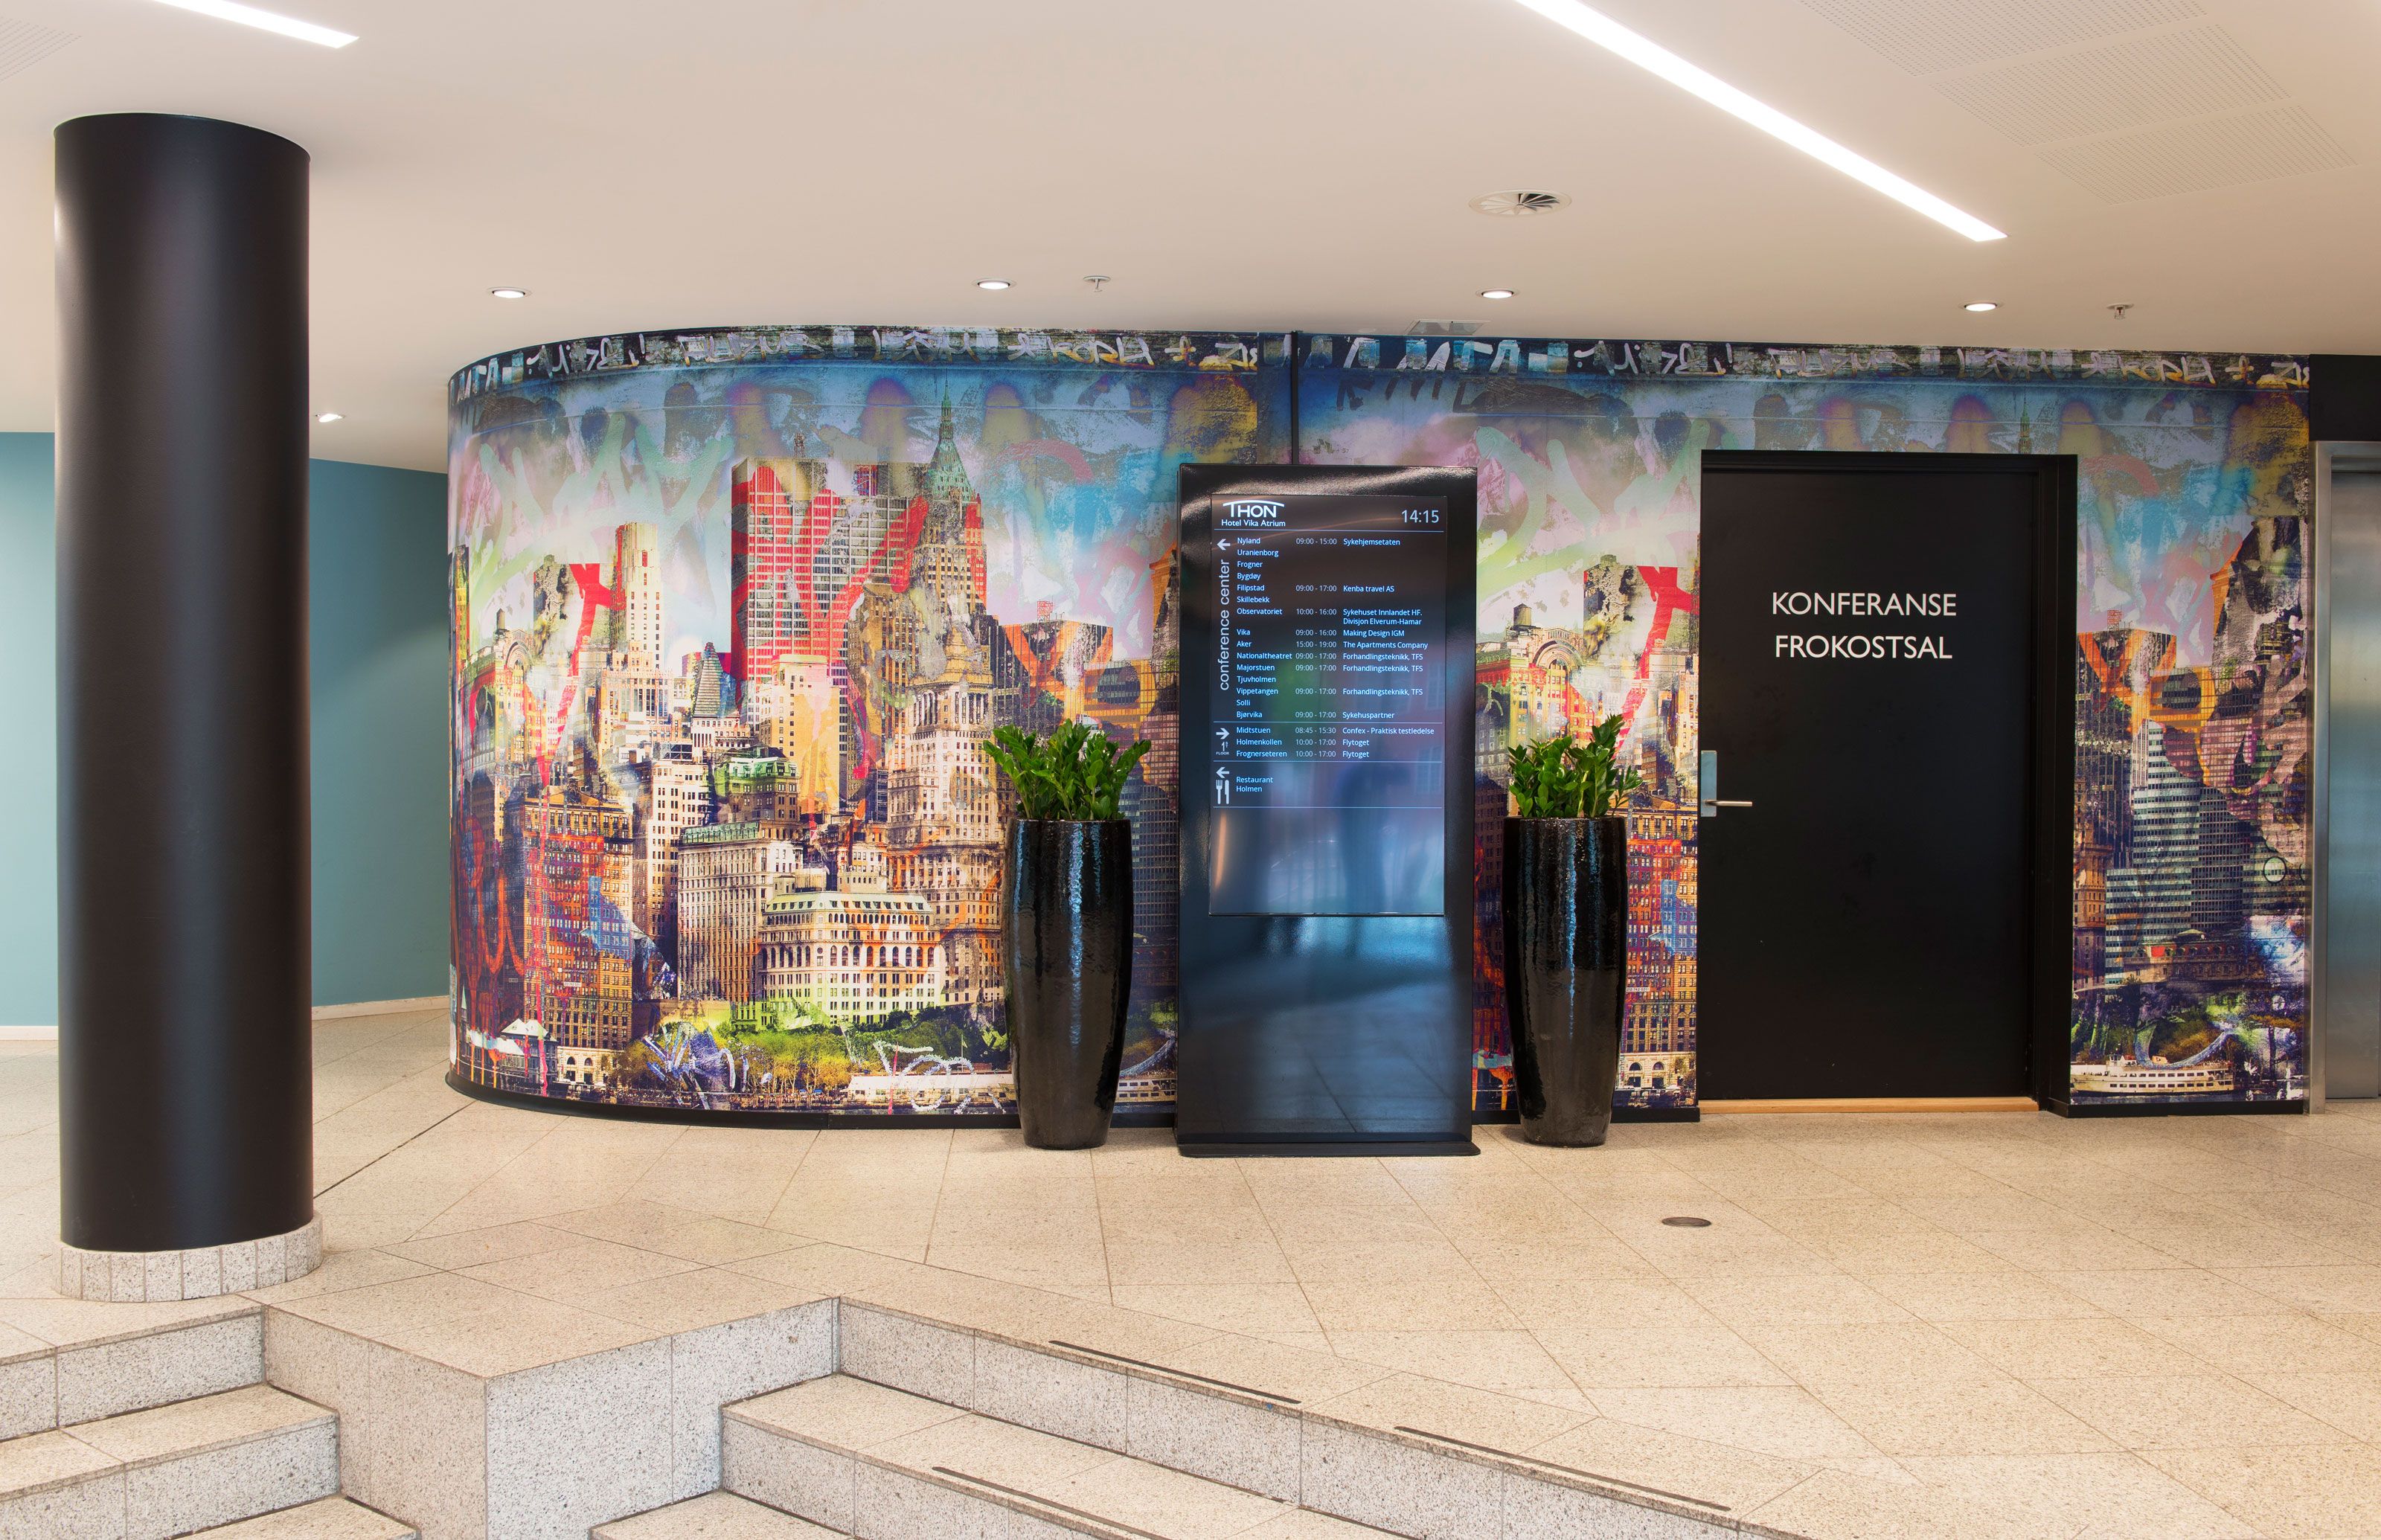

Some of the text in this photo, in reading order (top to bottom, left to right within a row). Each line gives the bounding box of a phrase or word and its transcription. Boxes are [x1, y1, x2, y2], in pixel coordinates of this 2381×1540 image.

[1222, 500, 1285, 518] THON
[1401, 510, 1439, 524] 14:15
[1221, 519, 1242, 527] Hotel
[1243, 519, 1259, 527] Vika
[1237, 537, 1261, 546] Nyland
[1343, 538, 1400, 547] Sykehjemsetaten
[1237, 549, 1279, 558] Uranienborg
[1237, 560, 1263, 569] Frogner
[1237, 572, 1261, 581] Bygdøy
[1237, 584, 1265, 593] Filipstad
[1772, 591, 1957, 616] KONFERANSE
[1237, 607, 1283, 615] Observatoriet
[1343, 609, 1377, 617] Sykehuset
[1218, 559, 1230, 690] conference center
[1343, 617, 1369, 626] Divisjon
[1343, 629, 1368, 638] Making
[1368, 629, 1391, 638] Design
[1356, 641, 1397, 649] Apartments
[1397, 641, 1429, 650] Company
[1775, 635, 1953, 659] FROKOSTSAL
[1342, 652, 1410, 662] Forhandlingsteknikk,
[1237, 664, 1275, 673] Majorstuen
[1343, 664, 1410, 673] Forhandlingsteknikk,
[1237, 676, 1277, 684] Tjuvholmen
[1236, 687, 1278, 696] Vippetangen
[1342, 687, 1410, 697] Forhandlingsteknikk,
[1236, 710, 1263, 719] Bjørvika
[1342, 711, 1395, 720] Sykehuspartner
[1342, 739, 1370, 748] Flytoget
[1236, 750, 1287, 759] Frognerseteren
[1342, 750, 1370, 759] Flytoget
